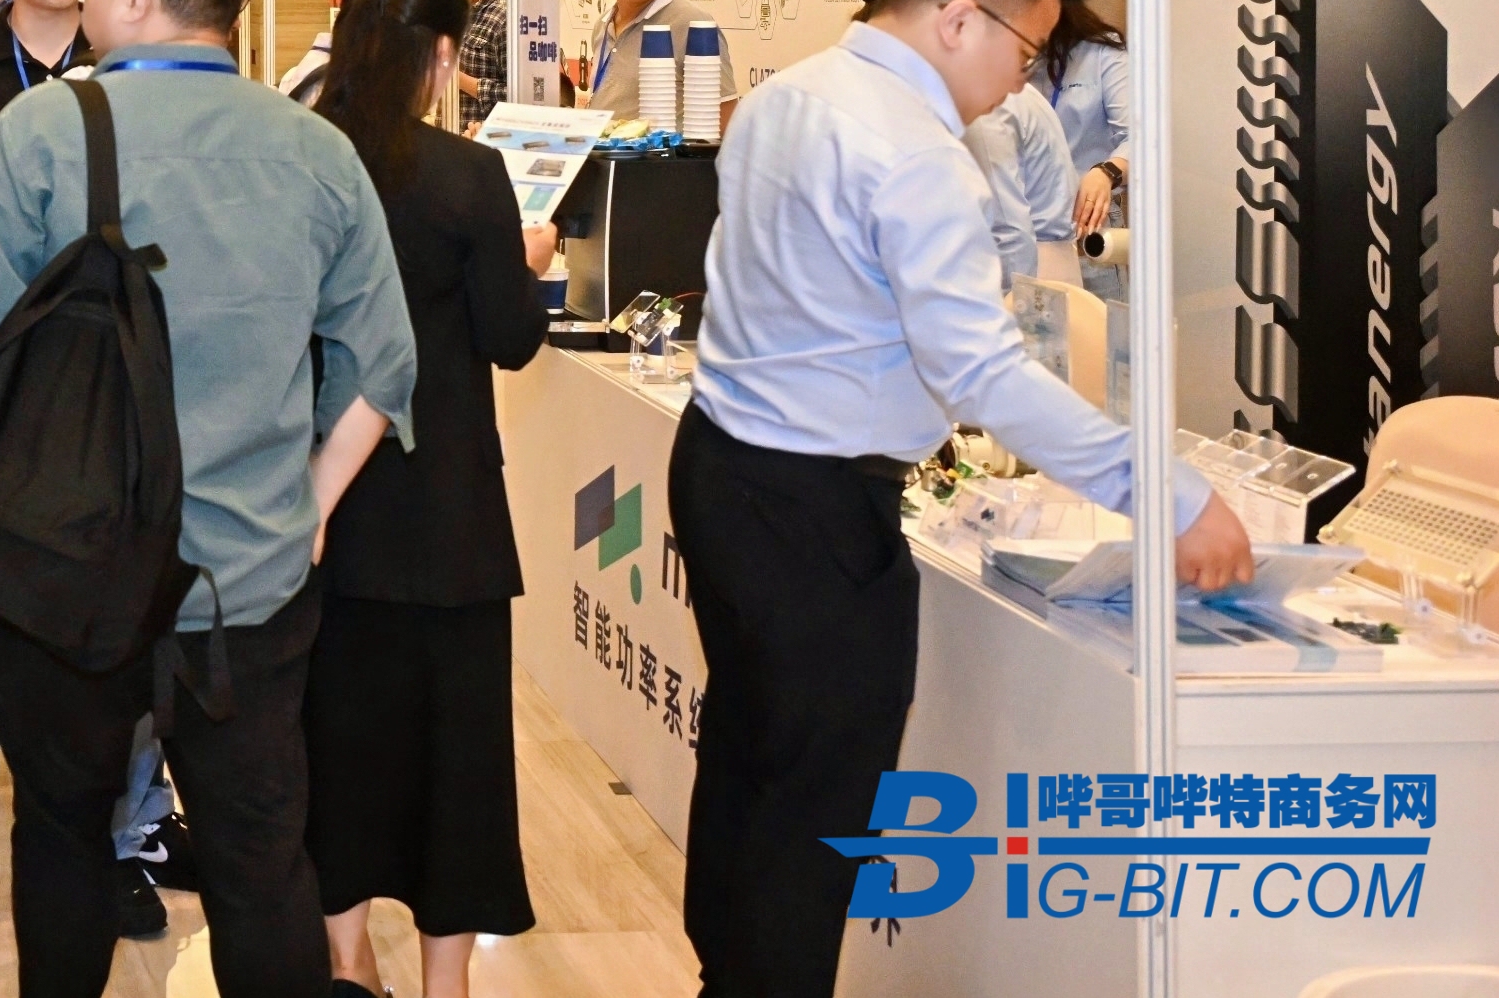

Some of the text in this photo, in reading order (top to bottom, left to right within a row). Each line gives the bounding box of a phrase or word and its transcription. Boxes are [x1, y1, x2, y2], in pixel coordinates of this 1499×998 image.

[520, 15, 547, 36] 扫一扫
[529, 41, 557, 62] 品咖啡
